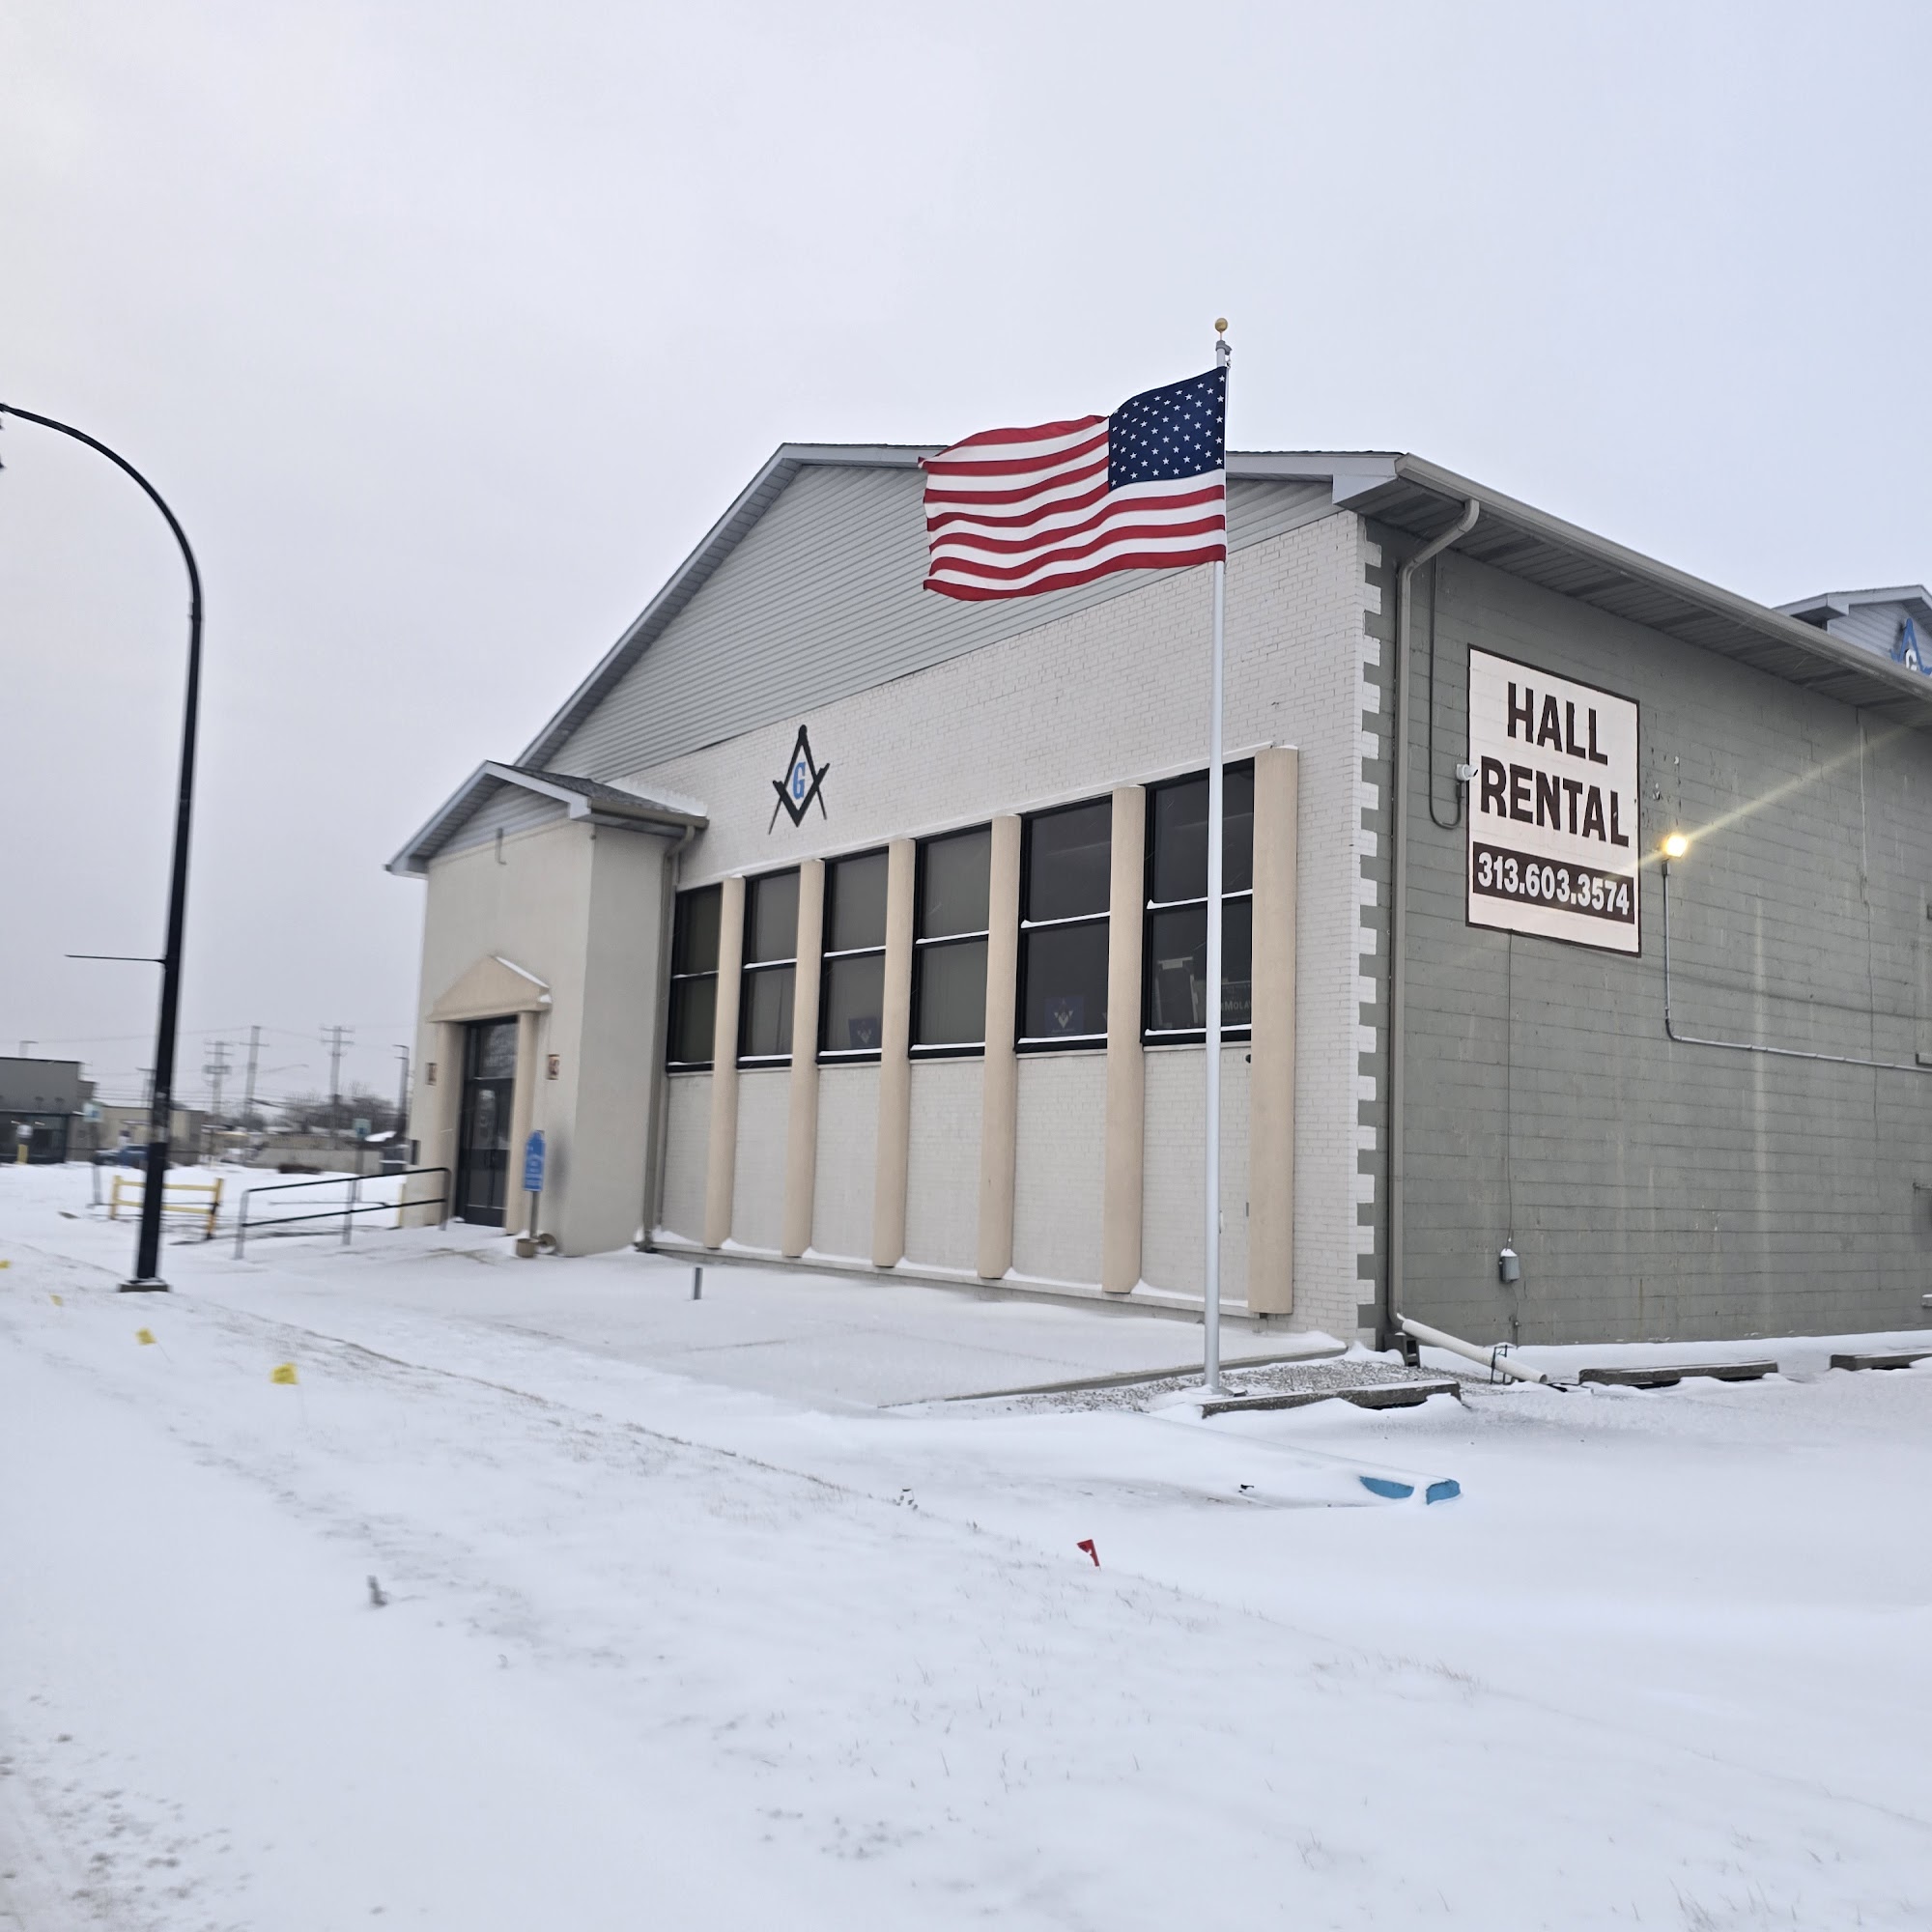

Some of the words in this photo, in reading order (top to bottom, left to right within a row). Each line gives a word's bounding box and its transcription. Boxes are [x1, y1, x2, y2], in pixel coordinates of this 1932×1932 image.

[1507, 681, 1608, 766] HALL
[792, 761, 807, 800] G
[1480, 754, 1630, 848] RENTAL
[1477, 851, 1631, 916] 313.603.3574
